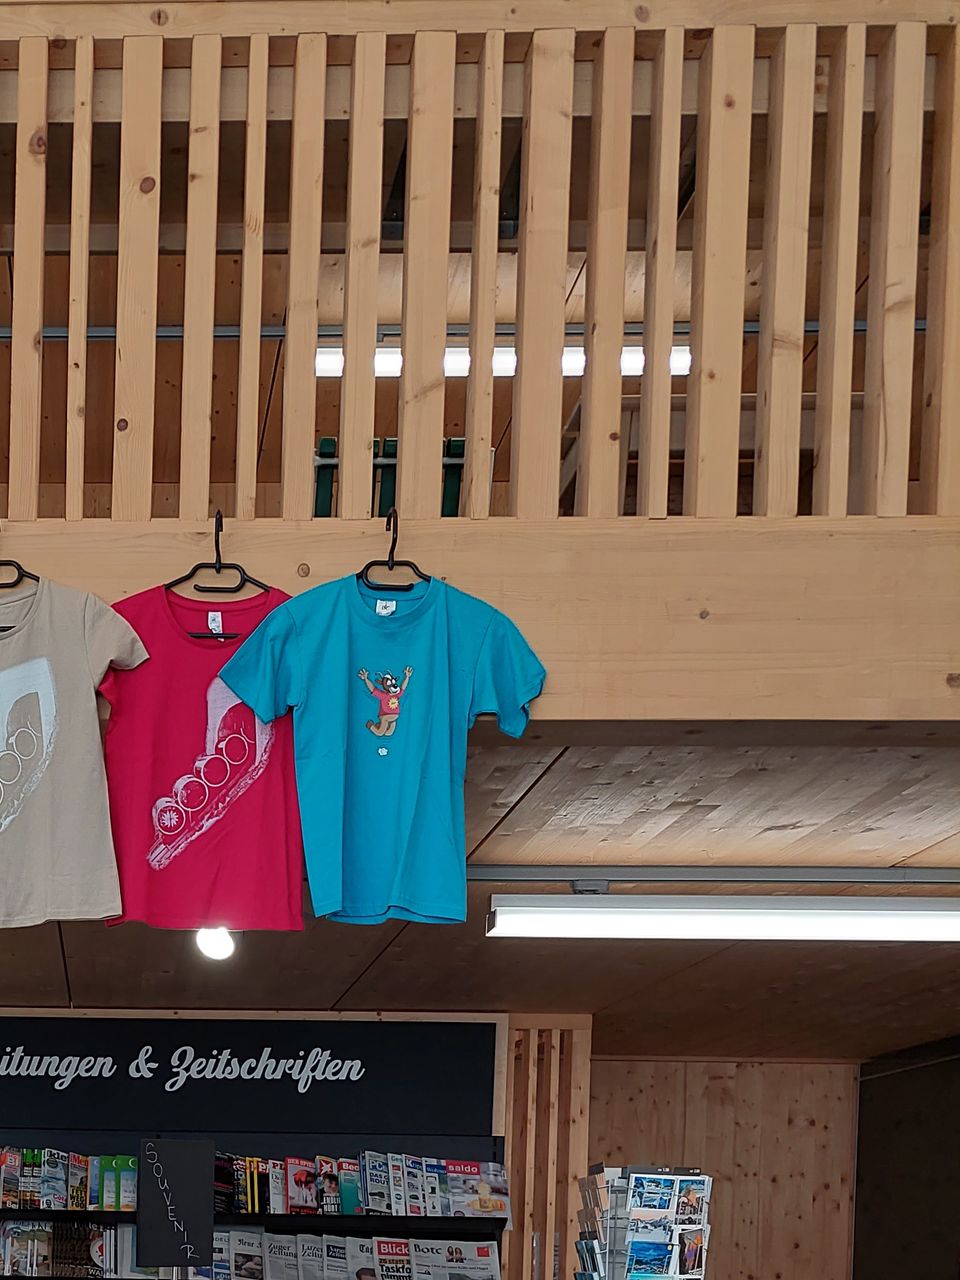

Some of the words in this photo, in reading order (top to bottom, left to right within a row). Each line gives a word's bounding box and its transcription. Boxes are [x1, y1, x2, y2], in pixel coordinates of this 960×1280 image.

[129, 1046, 159, 1078] &
[165, 1046, 366, 1093] Zeitschriften
[448, 1164, 478, 1173] saldo
[145, 1143, 200, 1259] SOUVENIR
[269, 1248, 298, 1259] Zeitung
[380, 1243, 409, 1254] Blick
